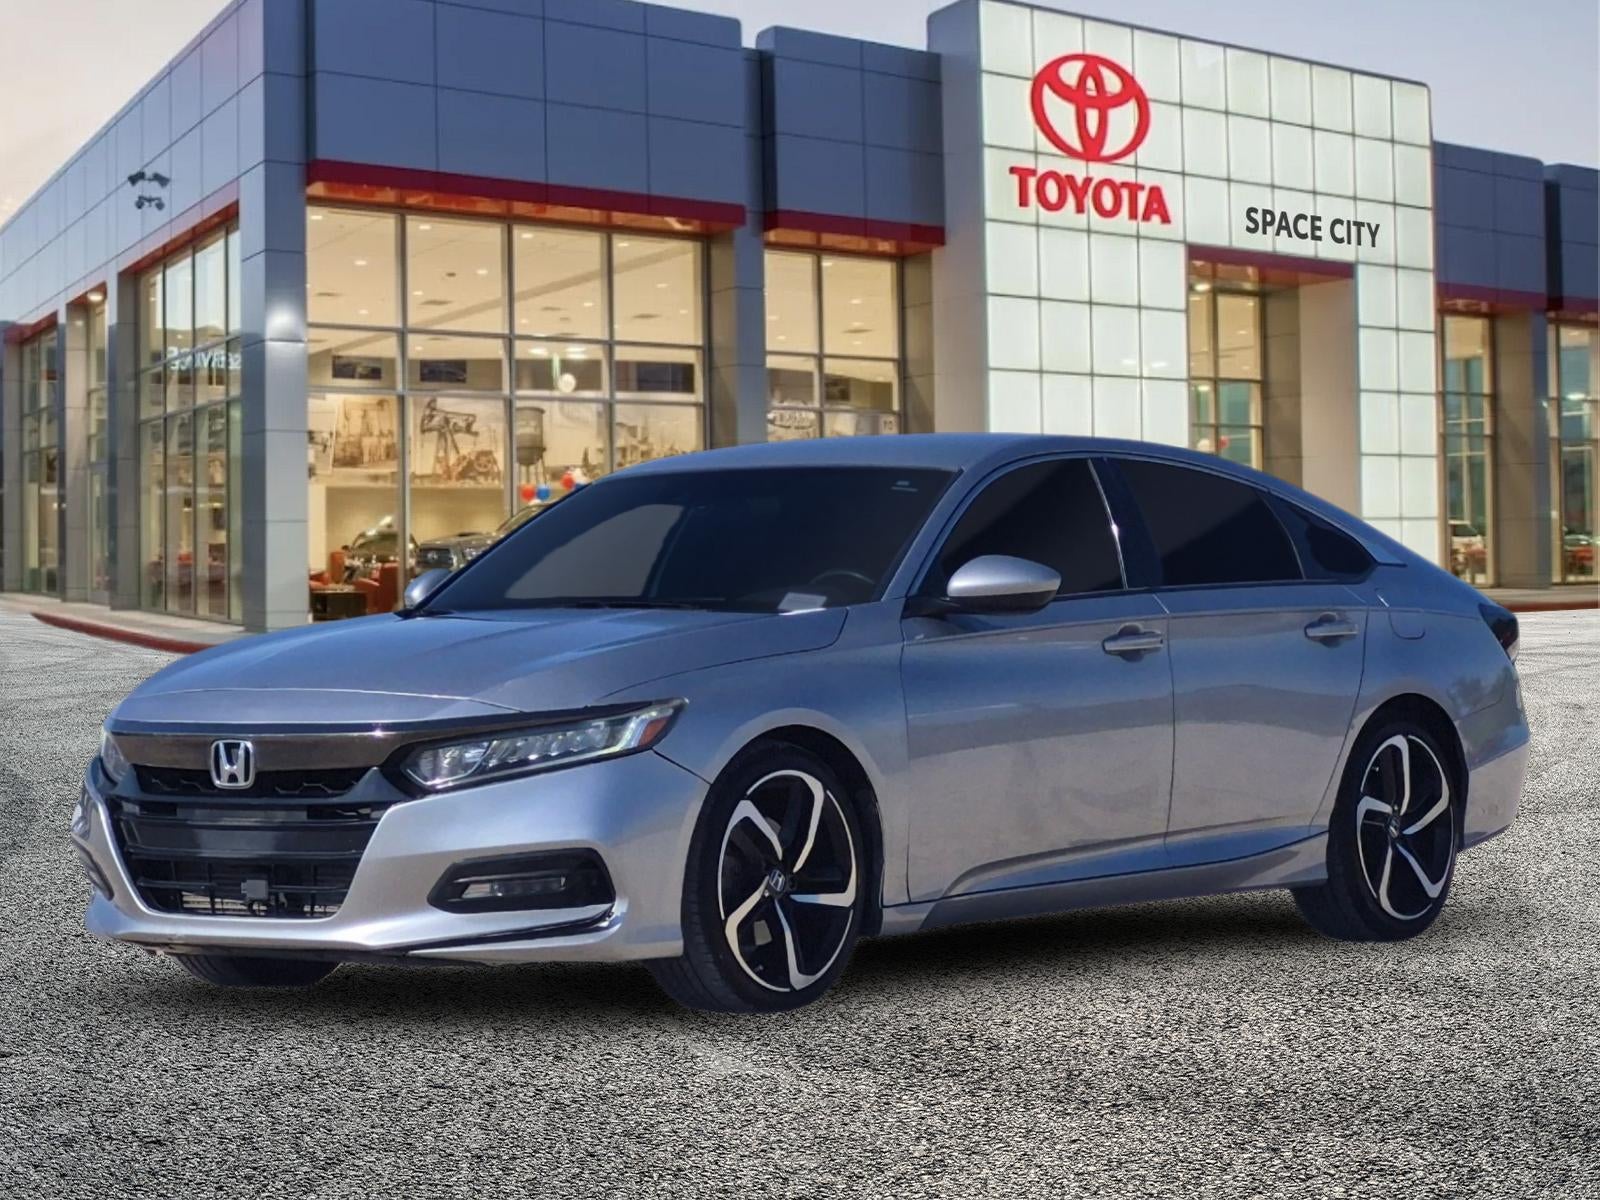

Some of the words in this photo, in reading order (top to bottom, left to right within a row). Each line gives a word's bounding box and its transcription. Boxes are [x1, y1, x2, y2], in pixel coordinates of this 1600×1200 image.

[1009, 166, 1171, 224] TOYOTA
[1245, 206, 1323, 242] SPACE
[1329, 217, 1381, 248] CITY
